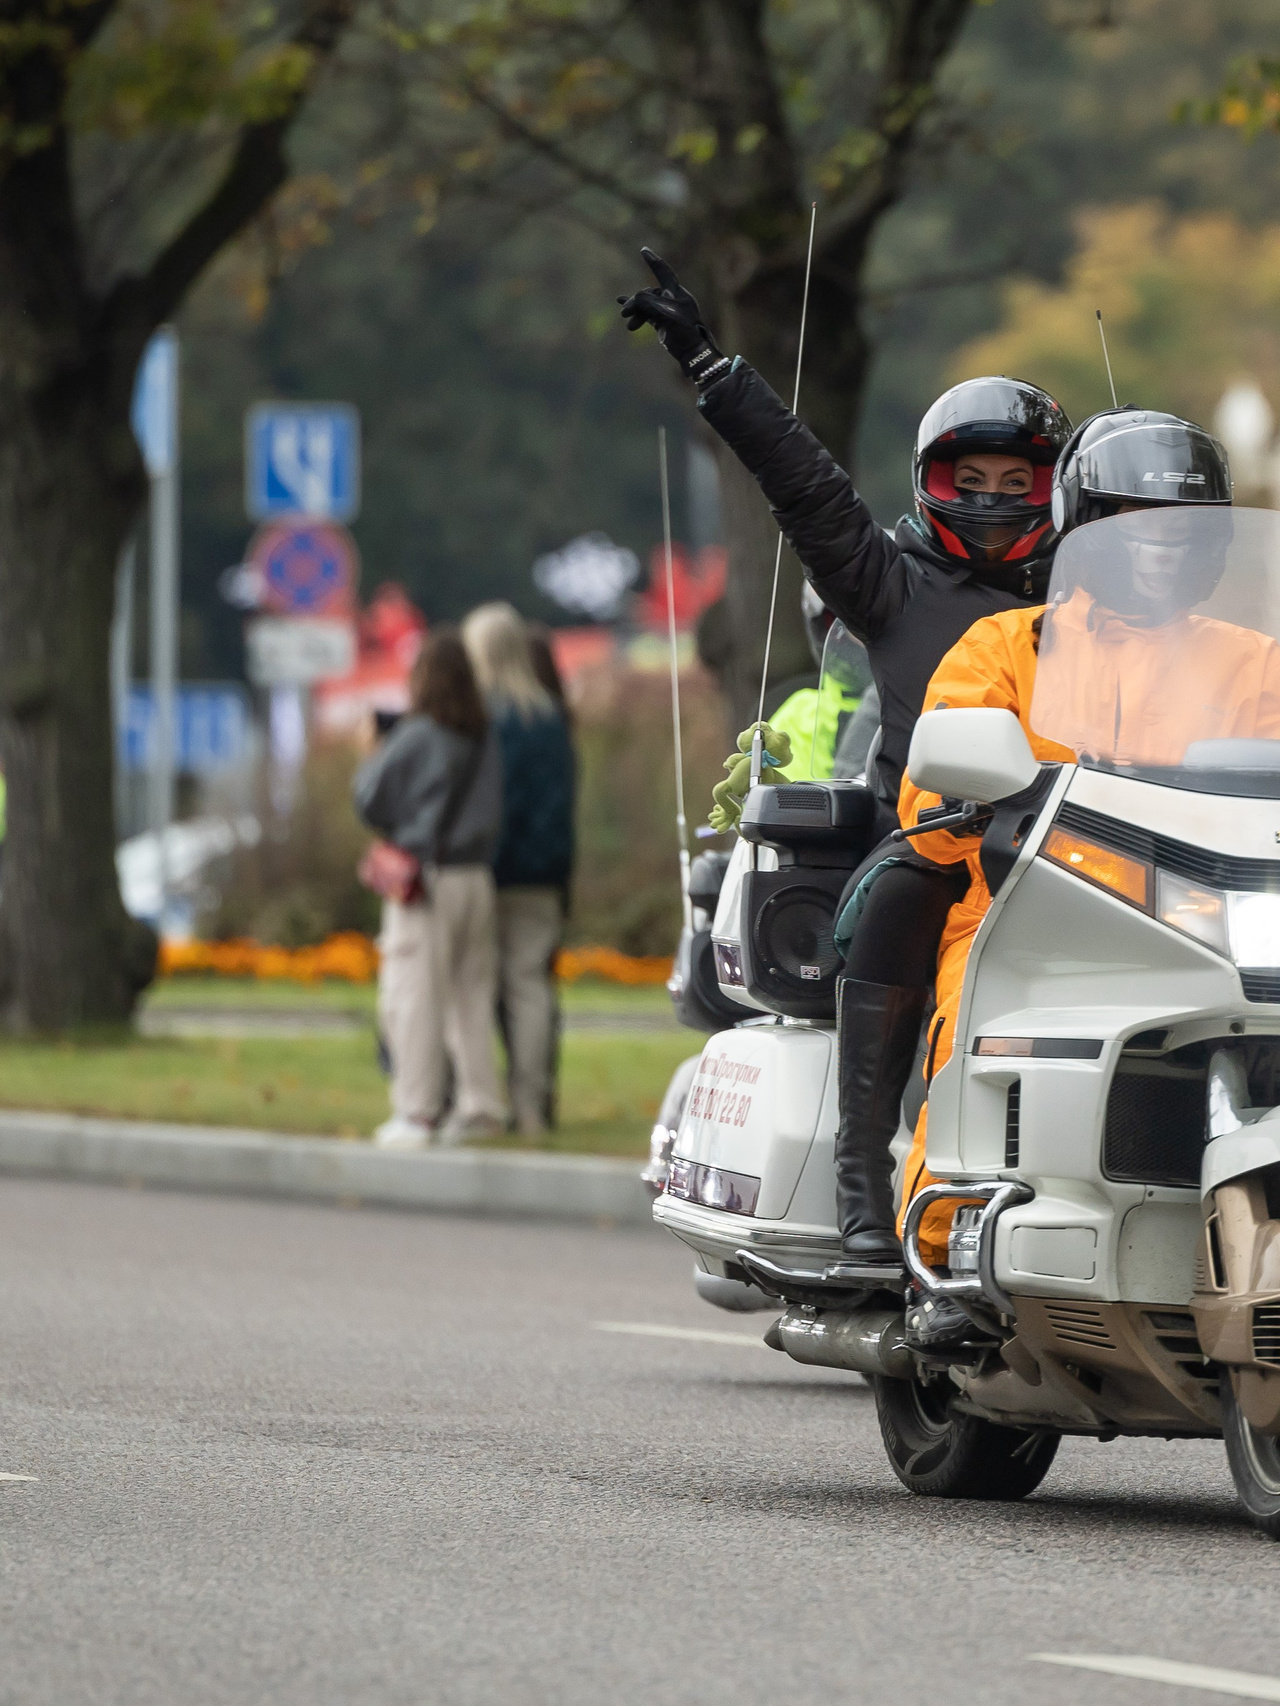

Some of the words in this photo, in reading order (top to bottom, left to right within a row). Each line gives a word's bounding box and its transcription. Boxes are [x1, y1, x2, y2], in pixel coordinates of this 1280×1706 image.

[689, 349, 712, 367] SUOMY
[1142, 472, 1206, 485] LS2
[719, 1092, 738, 1125] 22
[733, 1095, 752, 1128] 80
